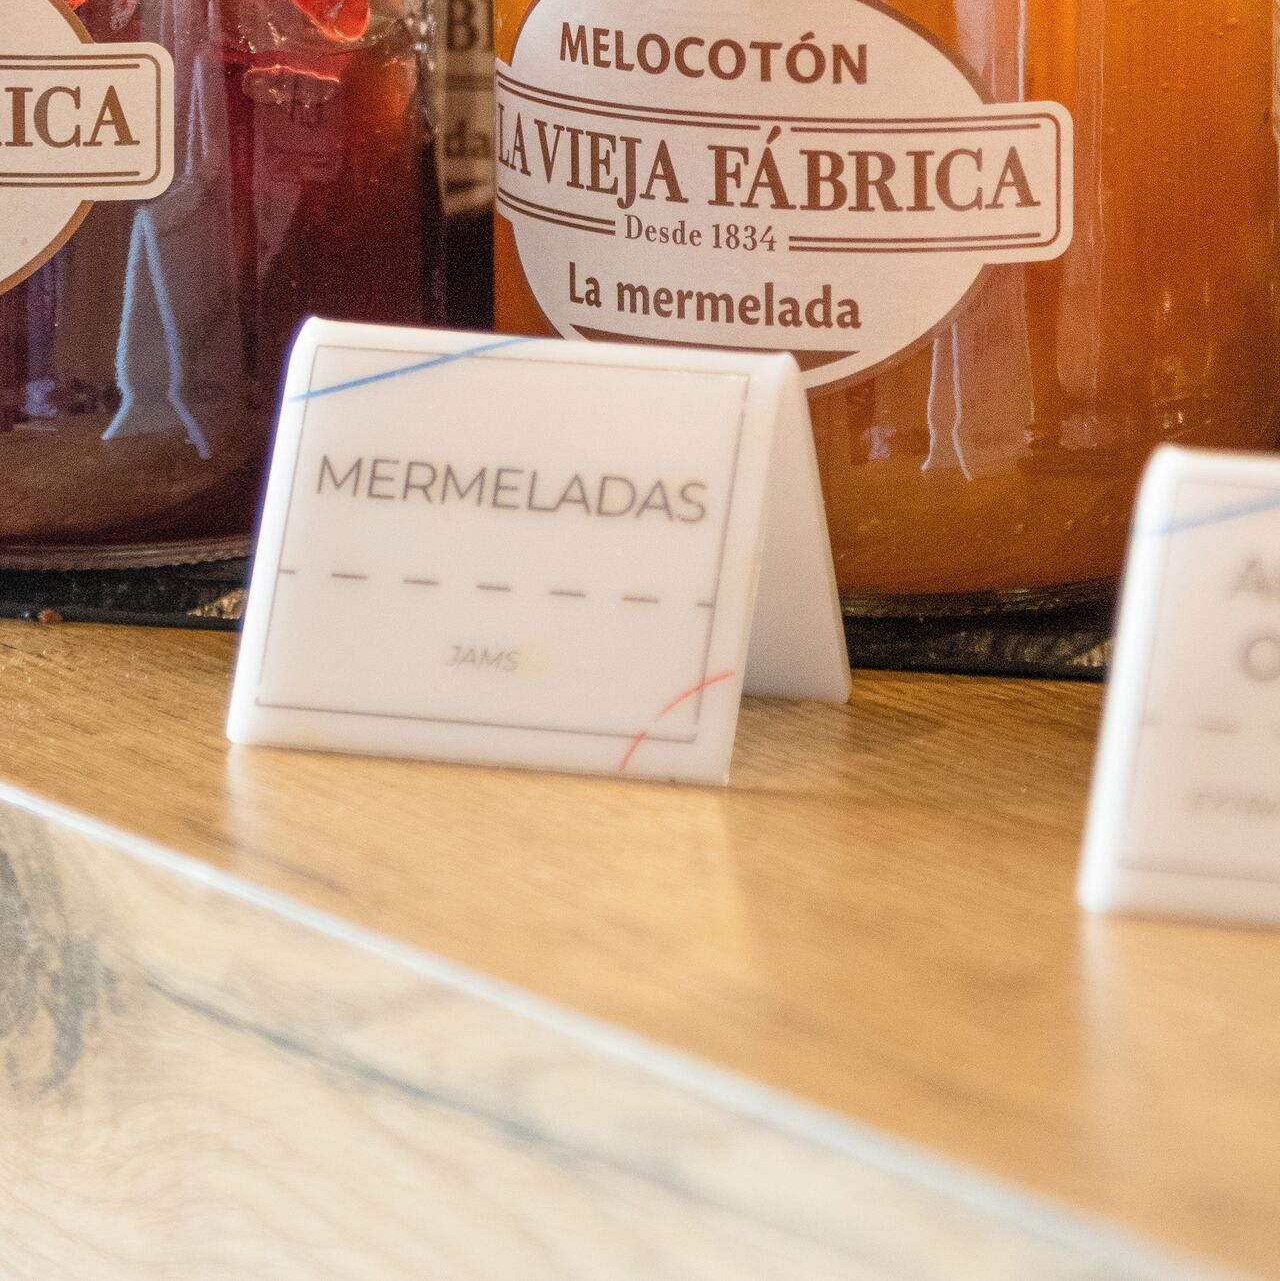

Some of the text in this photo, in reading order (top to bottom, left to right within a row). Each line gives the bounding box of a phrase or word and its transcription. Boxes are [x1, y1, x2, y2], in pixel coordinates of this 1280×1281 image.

[559, 21, 869, 86] MELOCOTÓN
[497, 102, 532, 177] LA
[533, 118, 690, 210] VIEJA
[706, 125, 1042, 213] FÁBRICA
[624, 214, 778, 252] Desde 1834
[568, 261, 863, 330] La mermelada
[316, 453, 709, 524] MERMELADAS
[444, 644, 520, 673] JAMS
